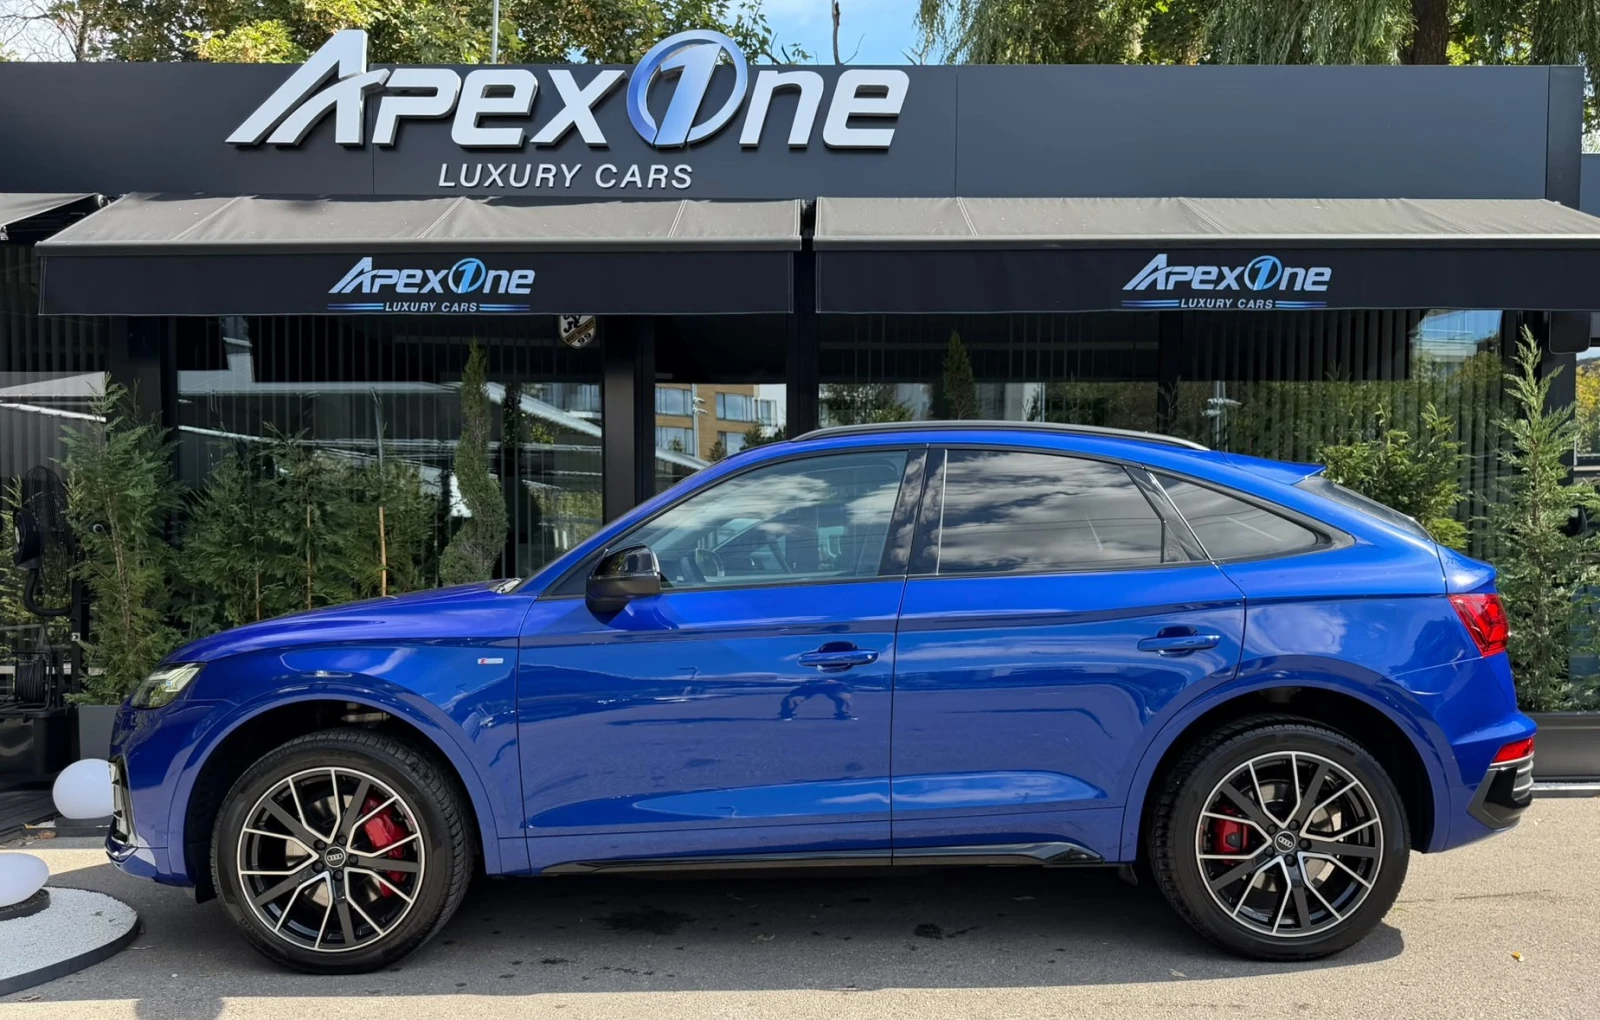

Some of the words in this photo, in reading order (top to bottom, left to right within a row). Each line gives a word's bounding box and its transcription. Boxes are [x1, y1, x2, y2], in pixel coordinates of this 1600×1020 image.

[438, 163, 582, 188] LUXURY
[594, 164, 693, 190] CARS
[385, 302, 436, 312] LUXURY
[441, 302, 477, 312] CARS
[1181, 299, 1232, 309] LUXURY
[1237, 299, 1273, 309] CARS
[577, 332, 592, 345] 99
